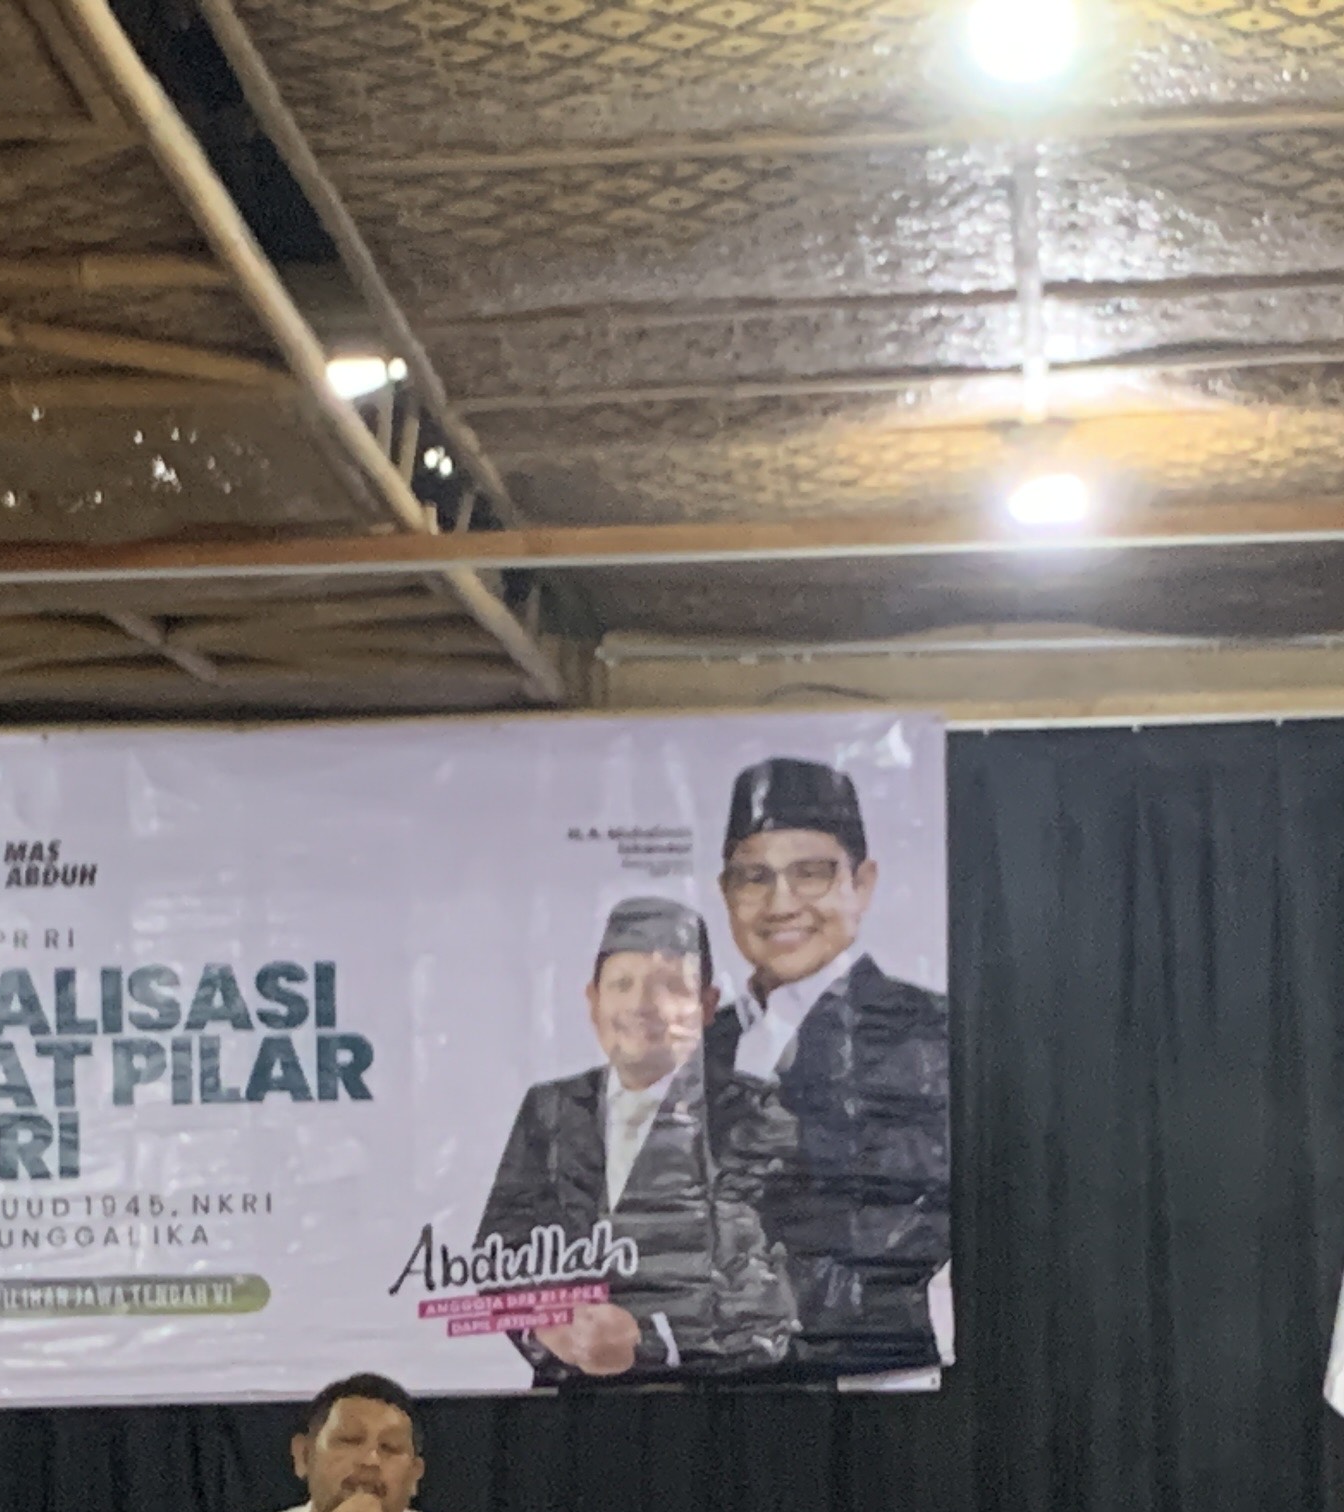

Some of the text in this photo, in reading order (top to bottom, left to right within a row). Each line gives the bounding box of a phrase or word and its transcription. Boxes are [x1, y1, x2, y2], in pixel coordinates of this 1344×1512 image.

[4, 839, 62, 863] MAS
[43, 927, 75, 949] RI
[111, 1031, 375, 1106] PILAR
[1, 1195, 70, 1220] UUD
[190, 1190, 274, 1215] NKRI
[153, 1222, 210, 1247] IKA
[388, 1222, 640, 1296] Abdullah
